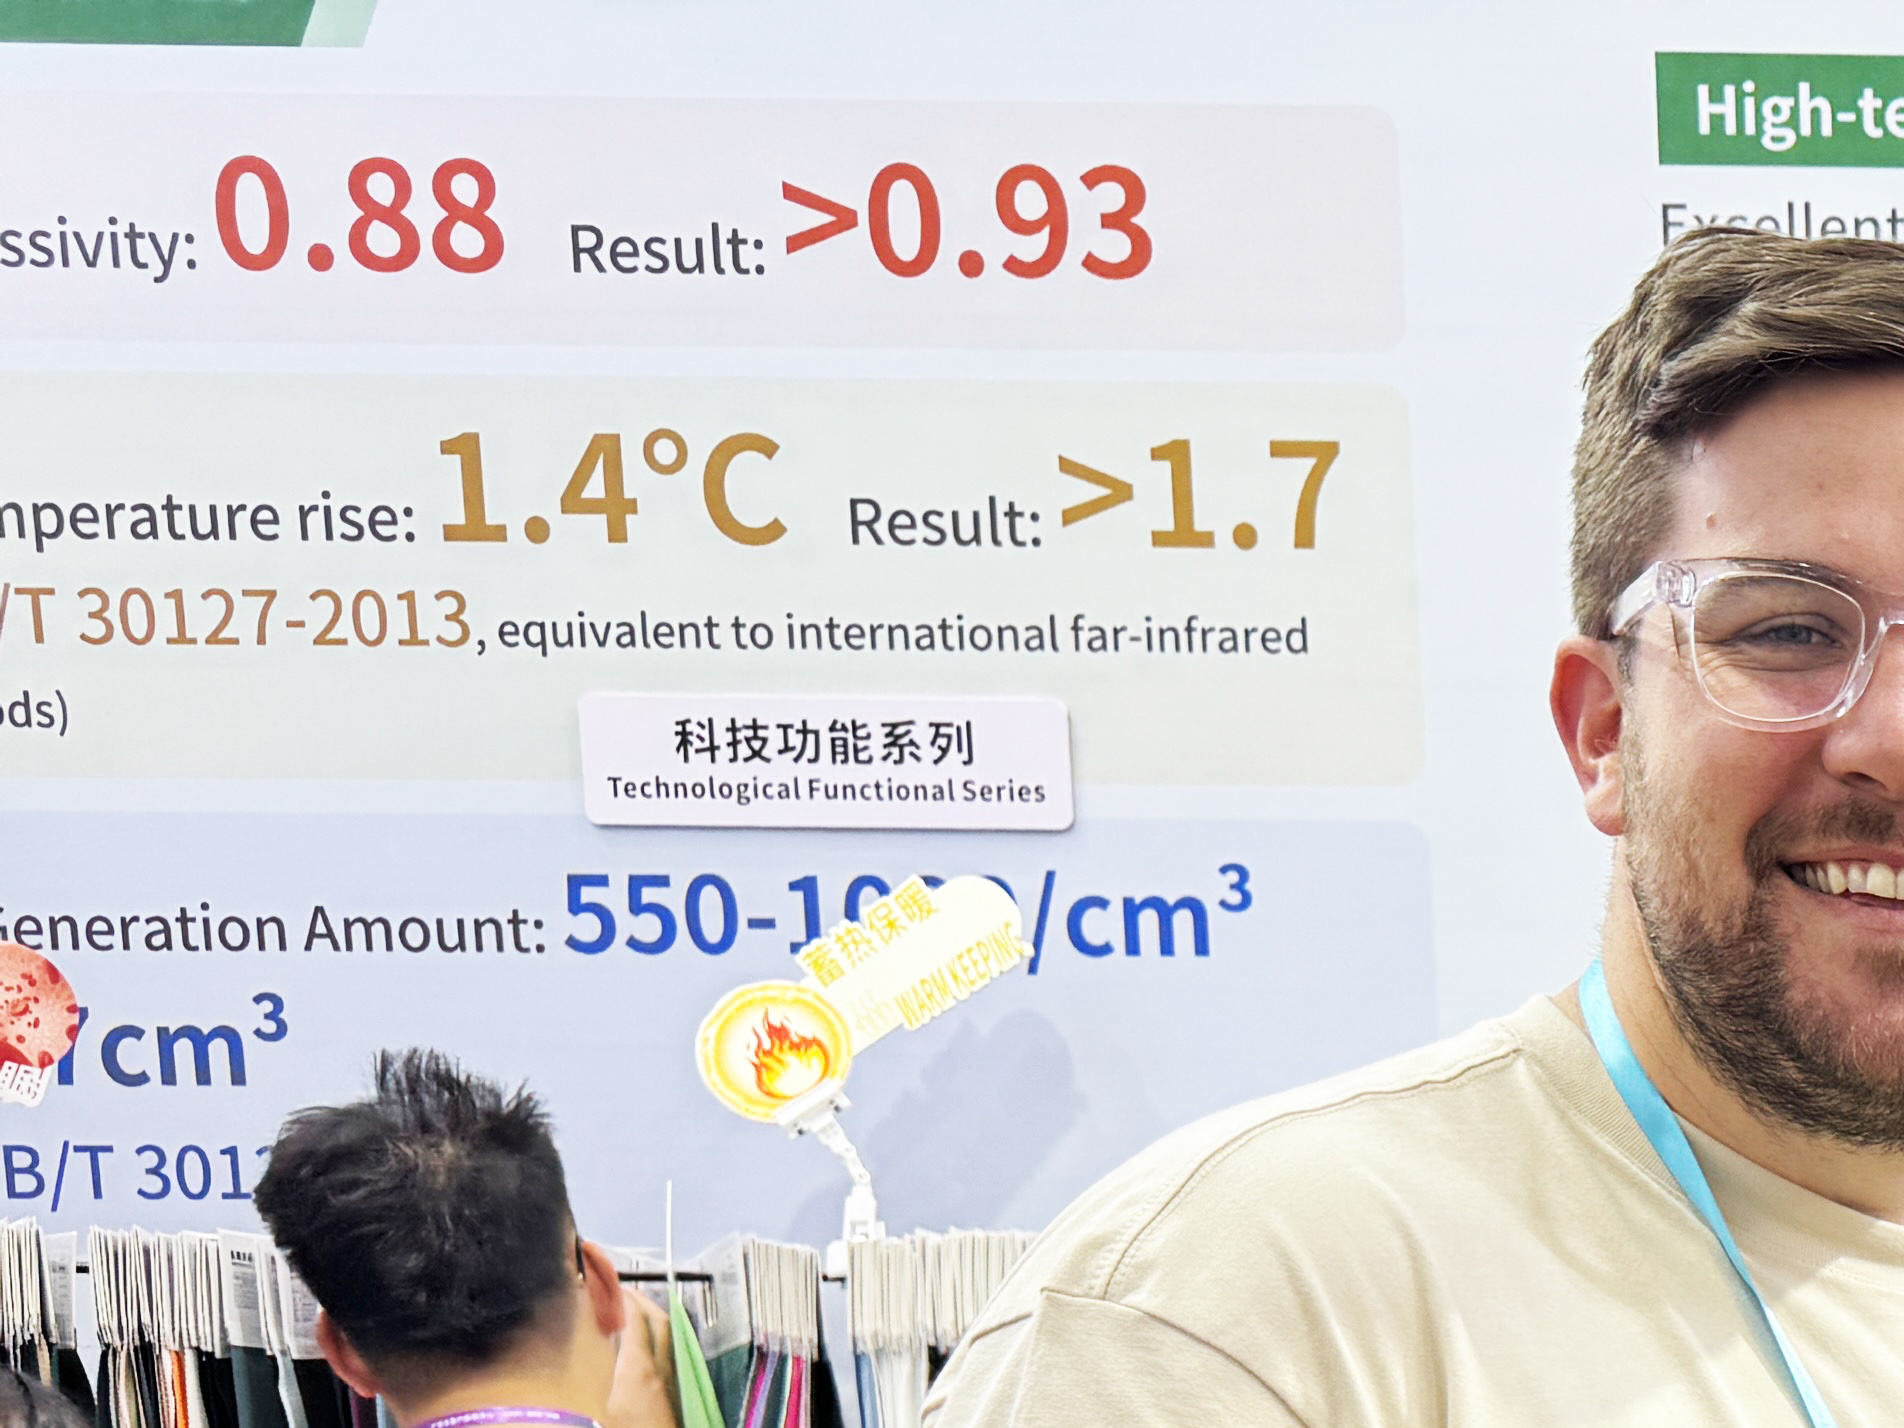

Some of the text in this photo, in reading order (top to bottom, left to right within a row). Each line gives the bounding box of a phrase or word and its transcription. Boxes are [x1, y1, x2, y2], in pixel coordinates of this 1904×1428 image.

[214, 156, 505, 273] 0.88
[570, 223, 767, 276] Result:
[782, 163, 1152, 281] >0.93
[299, 494, 417, 543] rise:
[439, 428, 790, 547] 1.4°C
[848, 495, 1043, 549] Result:
[1058, 439, 1341, 550] >1.7
[78, 587, 1308, 657] 30127-2013, equivalent to international far-infrared
[675, 717, 974, 767] 科技功能系列
[607, 776, 1046, 806] Technological Functional Series
[304, 904, 546, 954] Amount:
[803, 880, 939, 986] 蓄热保暖
[895, 921, 1024, 1022] WARM KEEPING
